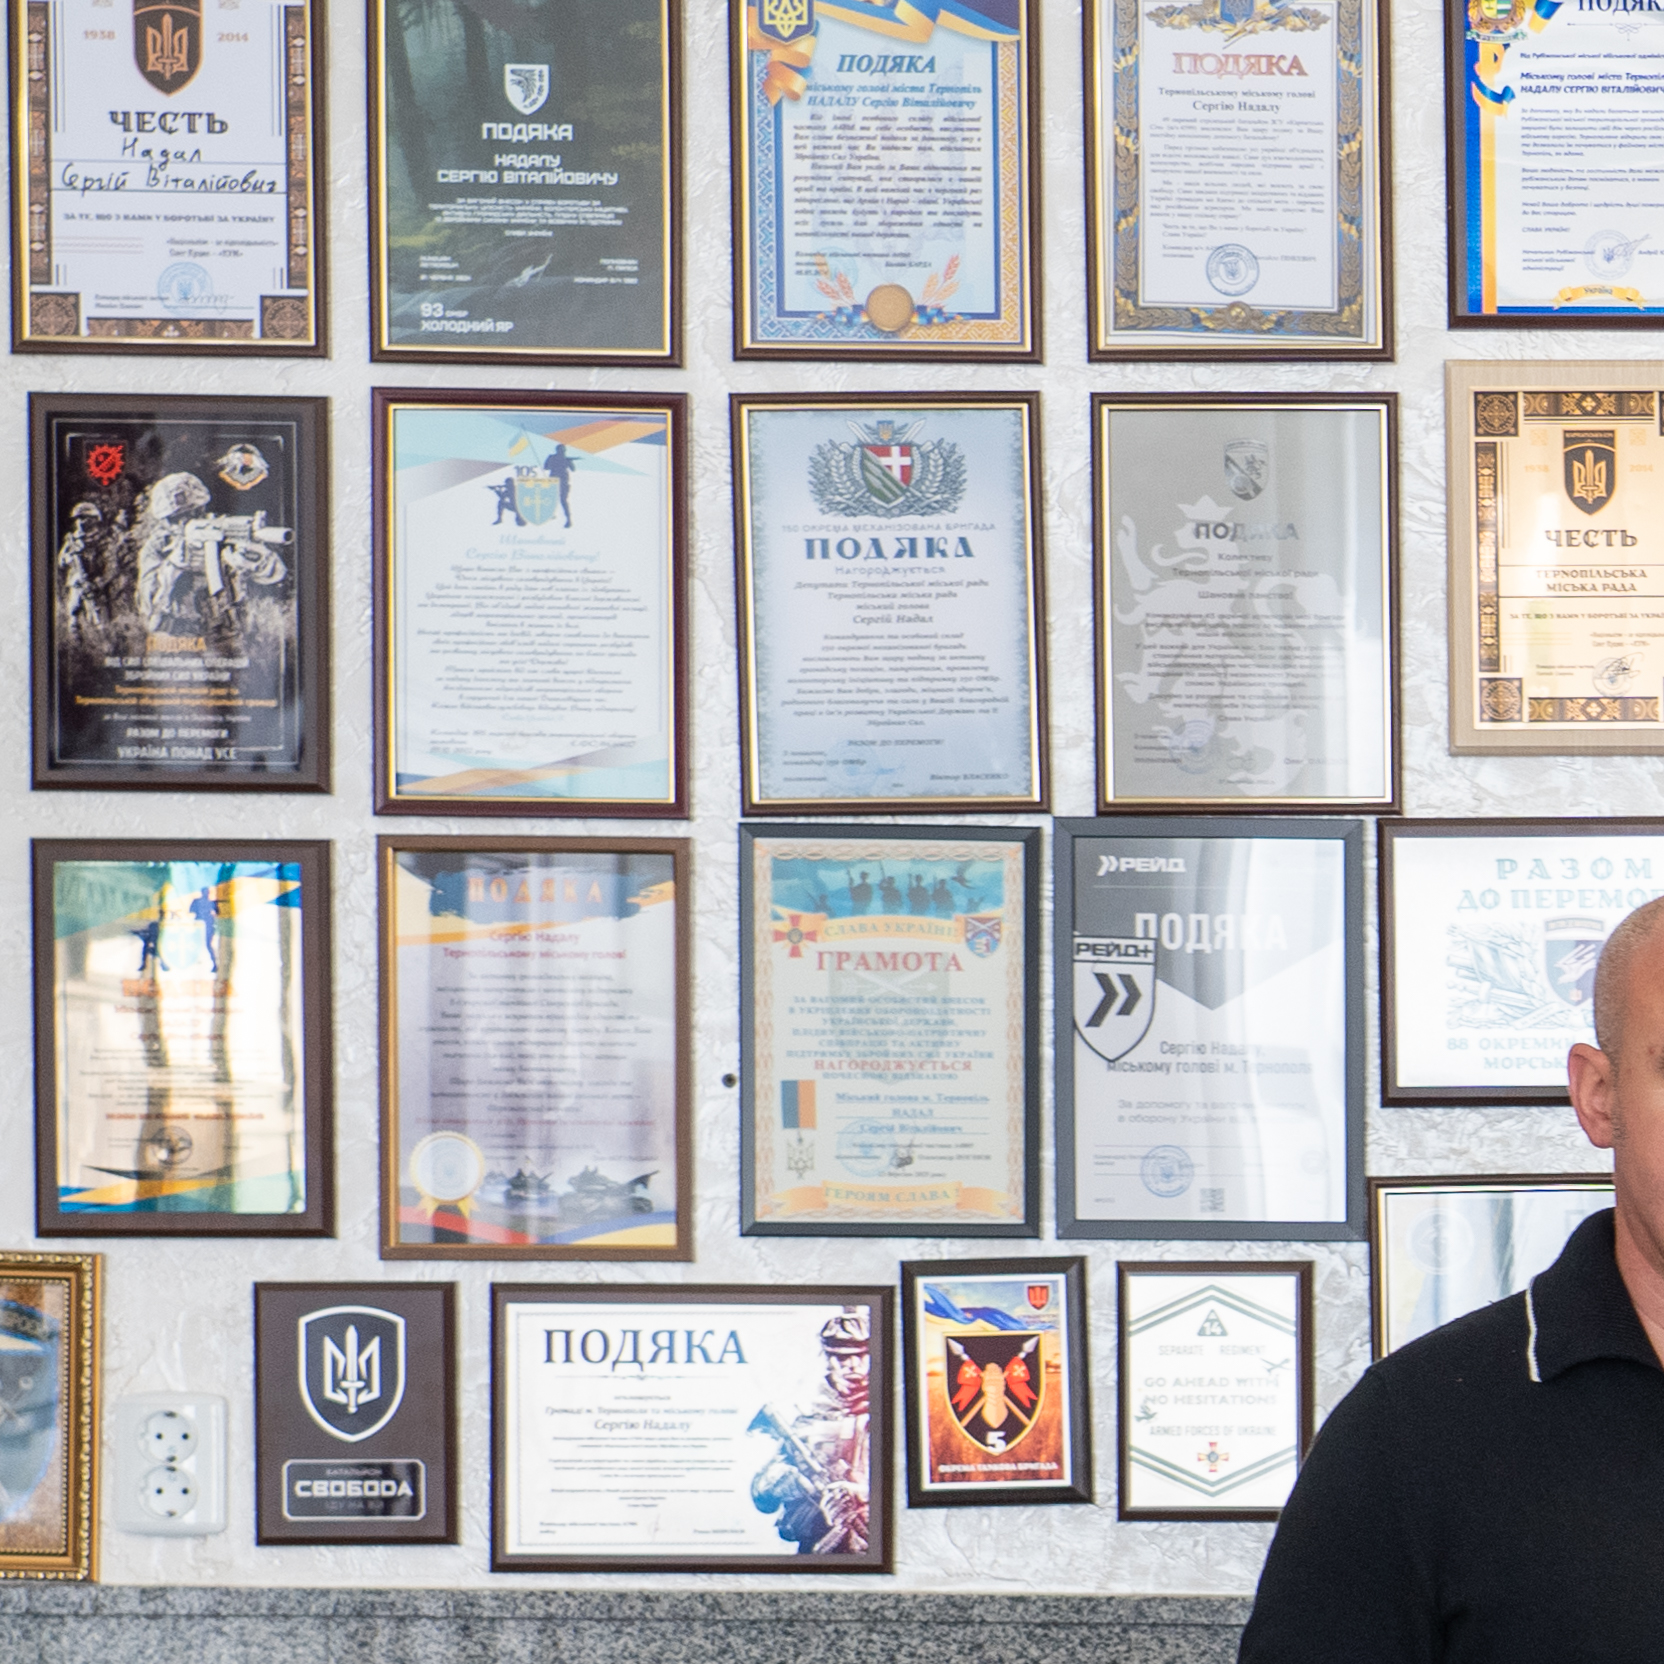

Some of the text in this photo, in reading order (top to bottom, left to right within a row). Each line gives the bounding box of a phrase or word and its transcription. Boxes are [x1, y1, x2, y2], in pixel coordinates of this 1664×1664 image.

[838, 54, 936, 75] ПОДЯКА
[1173, 52, 1308, 77] ПОДЯКА
[1193, 100, 1280, 115] Сергію Надалу
[109, 110, 228, 134] ЧЕСТЬ
[483, 123, 573, 141] ПОДЯКА
[438, 170, 499, 184] СЕРГІЮ
[1546, 529, 1637, 549] ЧЕСТЬ
[805, 537, 976, 561] ПОДЯКА
[1547, 581, 1637, 593] МІСЬКА РАДА
[1120, 858, 1185, 873] РЕЙД
[1496, 858, 1654, 880] РАЗОМ
[816, 951, 964, 973] ГРАМОТА
[1202, 1320, 1223, 1336] 14
[543, 1327, 748, 1372] ПОДЯКА
[1144, 1377, 1166, 1387] GO
[1173, 1376, 1229, 1388] AHEAD
[1144, 1394, 1277, 1405] NO HESITATIONS
[987, 1431, 1005, 1451] 5
[295, 1478, 413, 1497] СВОБОДА
